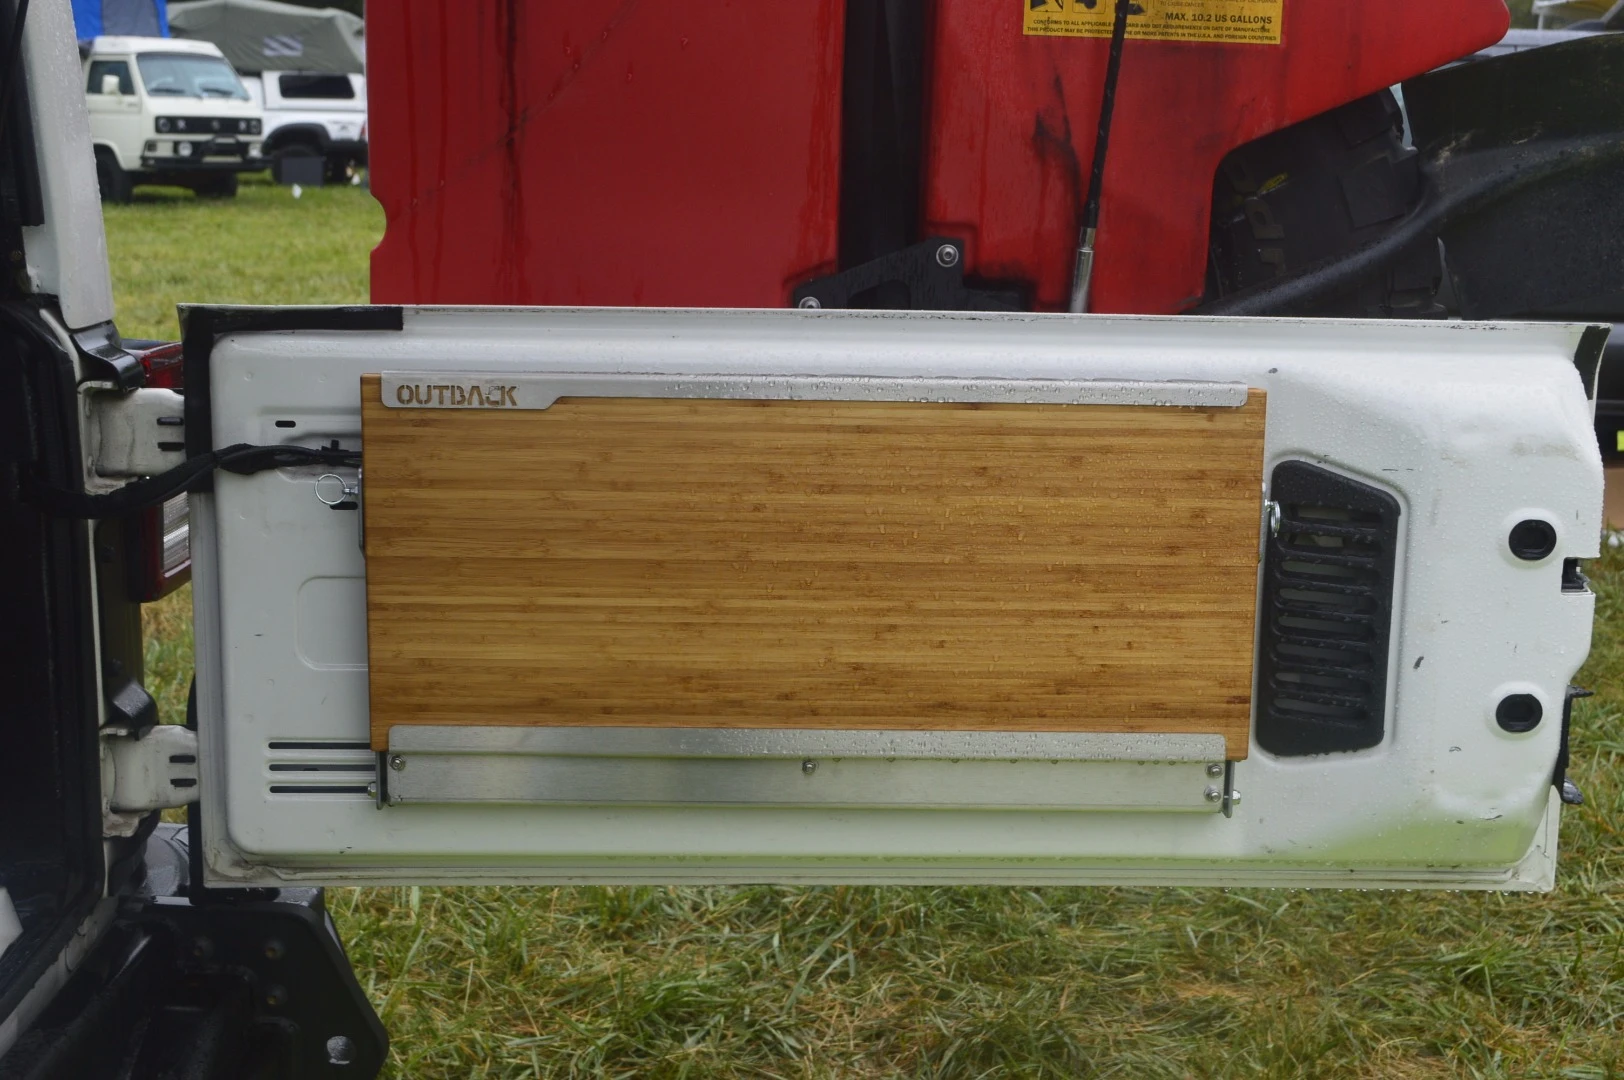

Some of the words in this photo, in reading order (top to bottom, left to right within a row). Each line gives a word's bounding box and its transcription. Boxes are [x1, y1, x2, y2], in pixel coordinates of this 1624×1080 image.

[1165, 12, 1188, 21] MAX.
[1191, 14, 1211, 22] 10.2
[1215, 14, 1227, 22] US
[1230, 15, 1272, 24] GALLONS
[396, 384, 518, 407] OUTBACK
